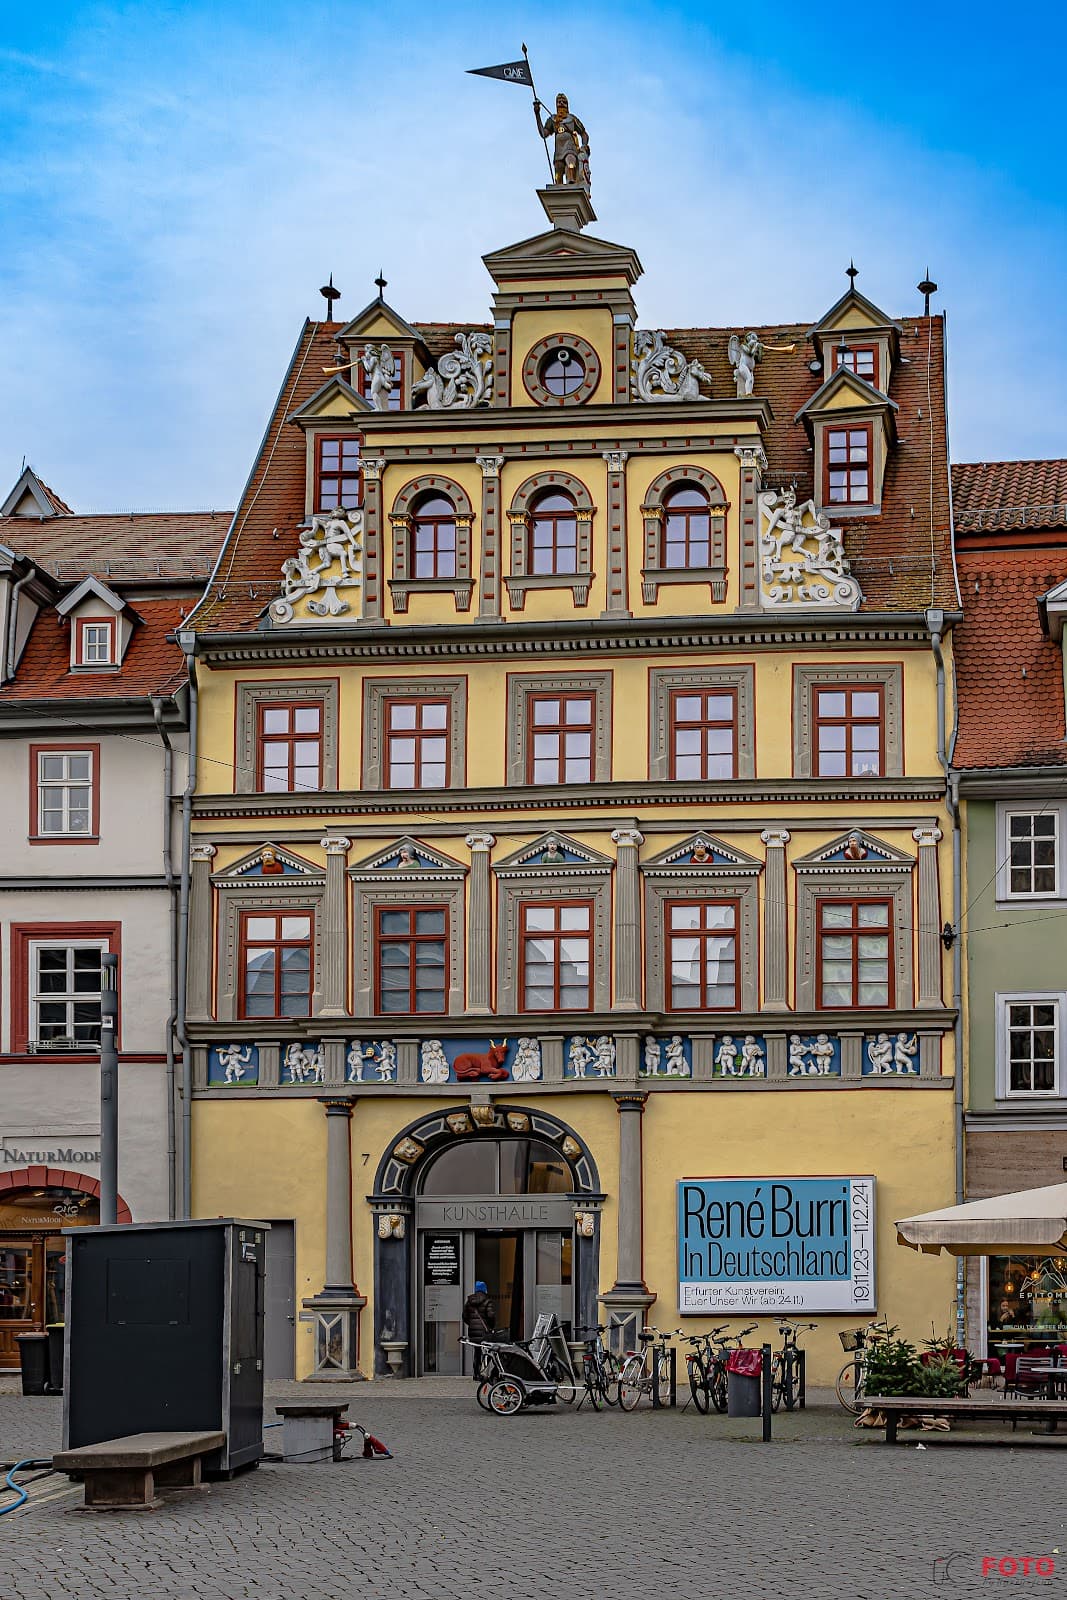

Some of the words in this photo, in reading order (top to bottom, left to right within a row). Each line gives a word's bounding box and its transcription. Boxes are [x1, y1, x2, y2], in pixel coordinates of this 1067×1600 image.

[362, 1153, 370, 1166] 7
[443, 1205, 548, 1221] KUNSTHALLE
[683, 1186, 765, 1239] René
[771, 1184, 848, 1238] Burri
[684, 1242, 703, 1277] In
[708, 1240, 848, 1277] Deutschland
[684, 1286, 723, 1296] Erfurter
[725, 1286, 785, 1296] Kunstverein:
[684, 1296, 708, 1306] Euer
[709, 1296, 739, 1306] Unser
[741, 1295, 758, 1305] Wir
[760, 1295, 776, 1306] (ab
[778, 1295, 804, 1305] 24.11.)
